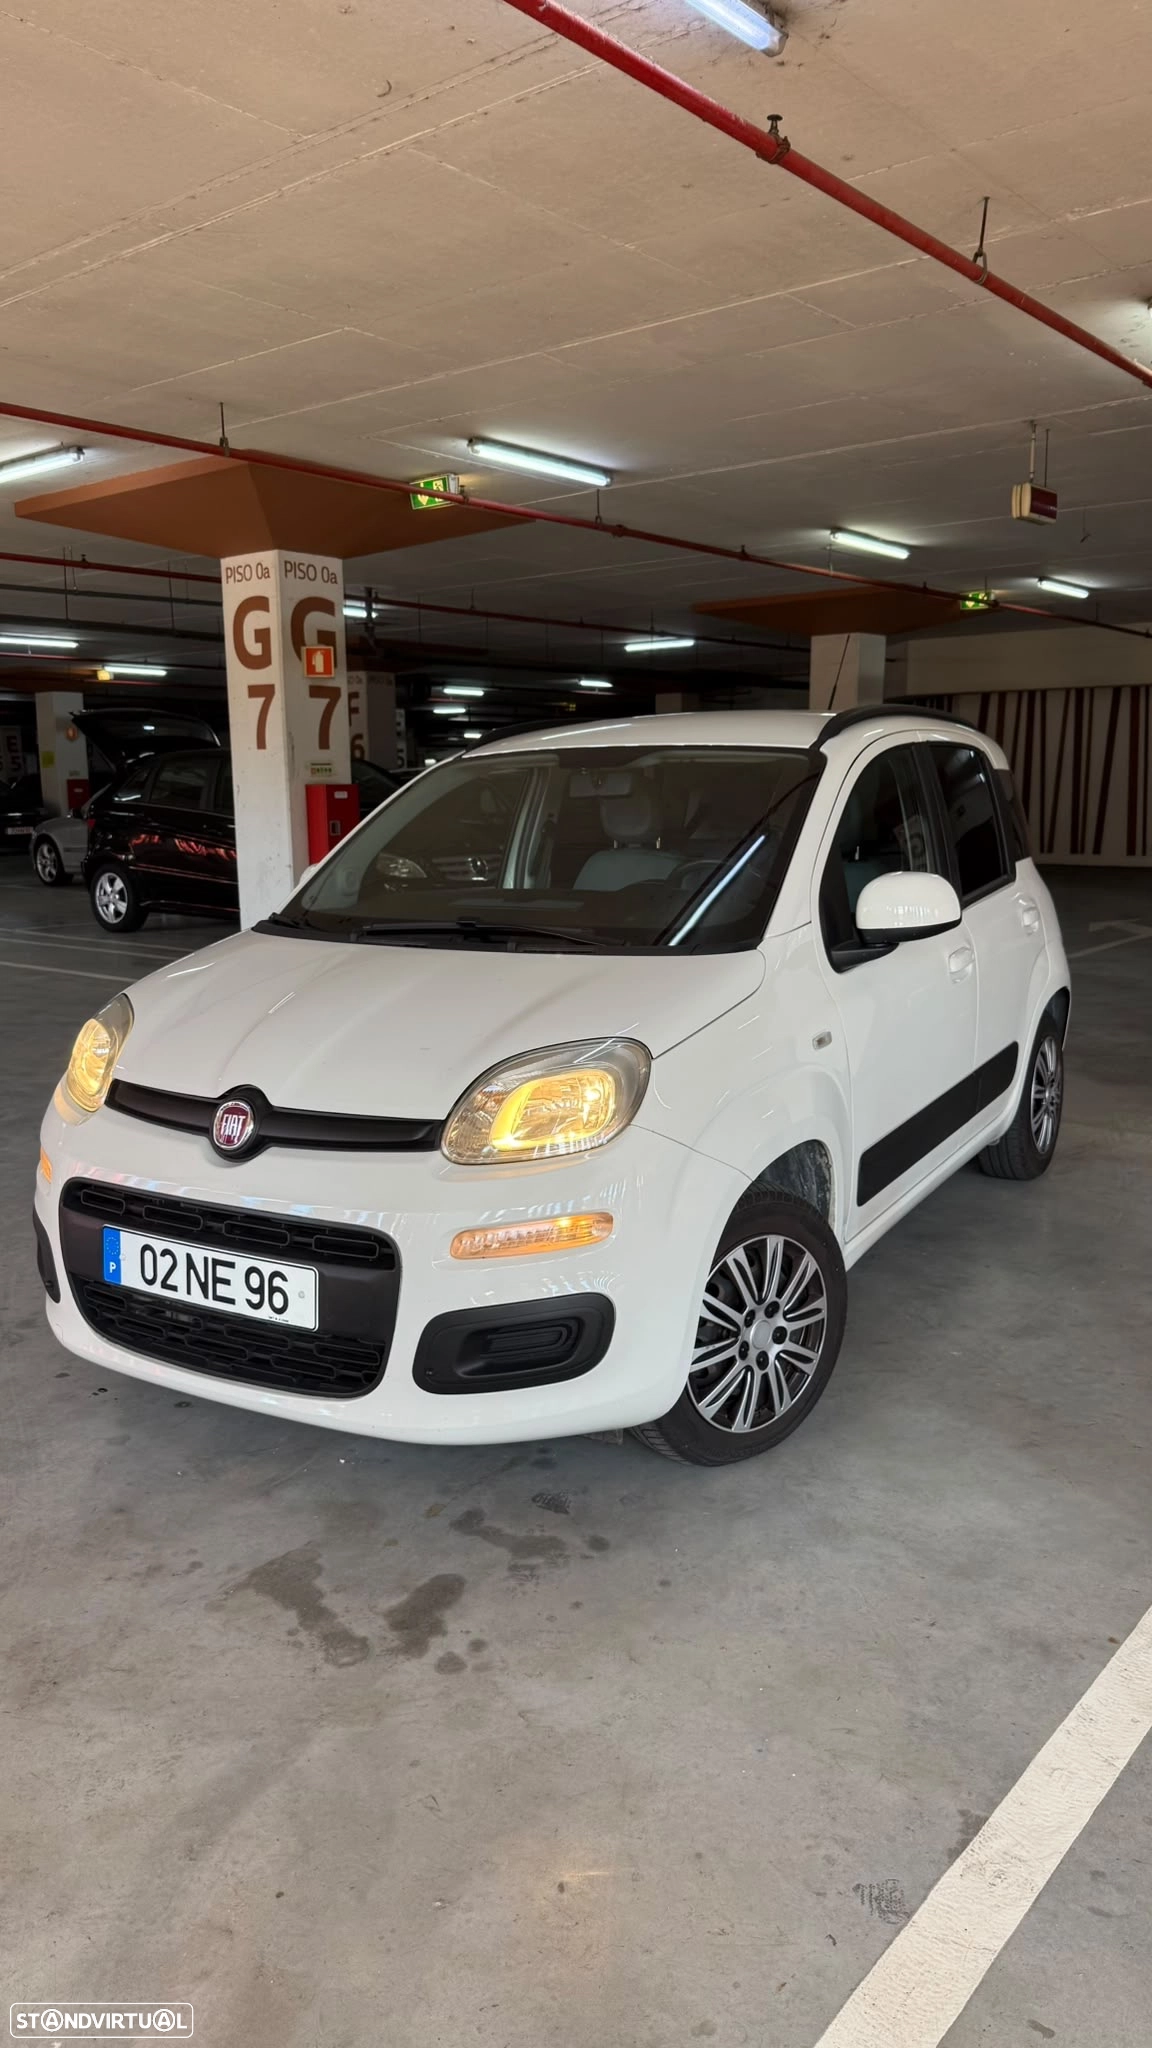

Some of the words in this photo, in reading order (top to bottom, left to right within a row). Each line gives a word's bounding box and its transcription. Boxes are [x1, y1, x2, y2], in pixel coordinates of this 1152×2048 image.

[225, 564, 253, 584] PISO
[284, 560, 317, 581] PISO
[233, 595, 273, 670] G
[290, 596, 338, 669] G
[248, 684, 275, 750] 7
[309, 685, 341, 750] 7
[221, 1112, 246, 1140] FIAT
[109, 1262, 116, 1273] P
